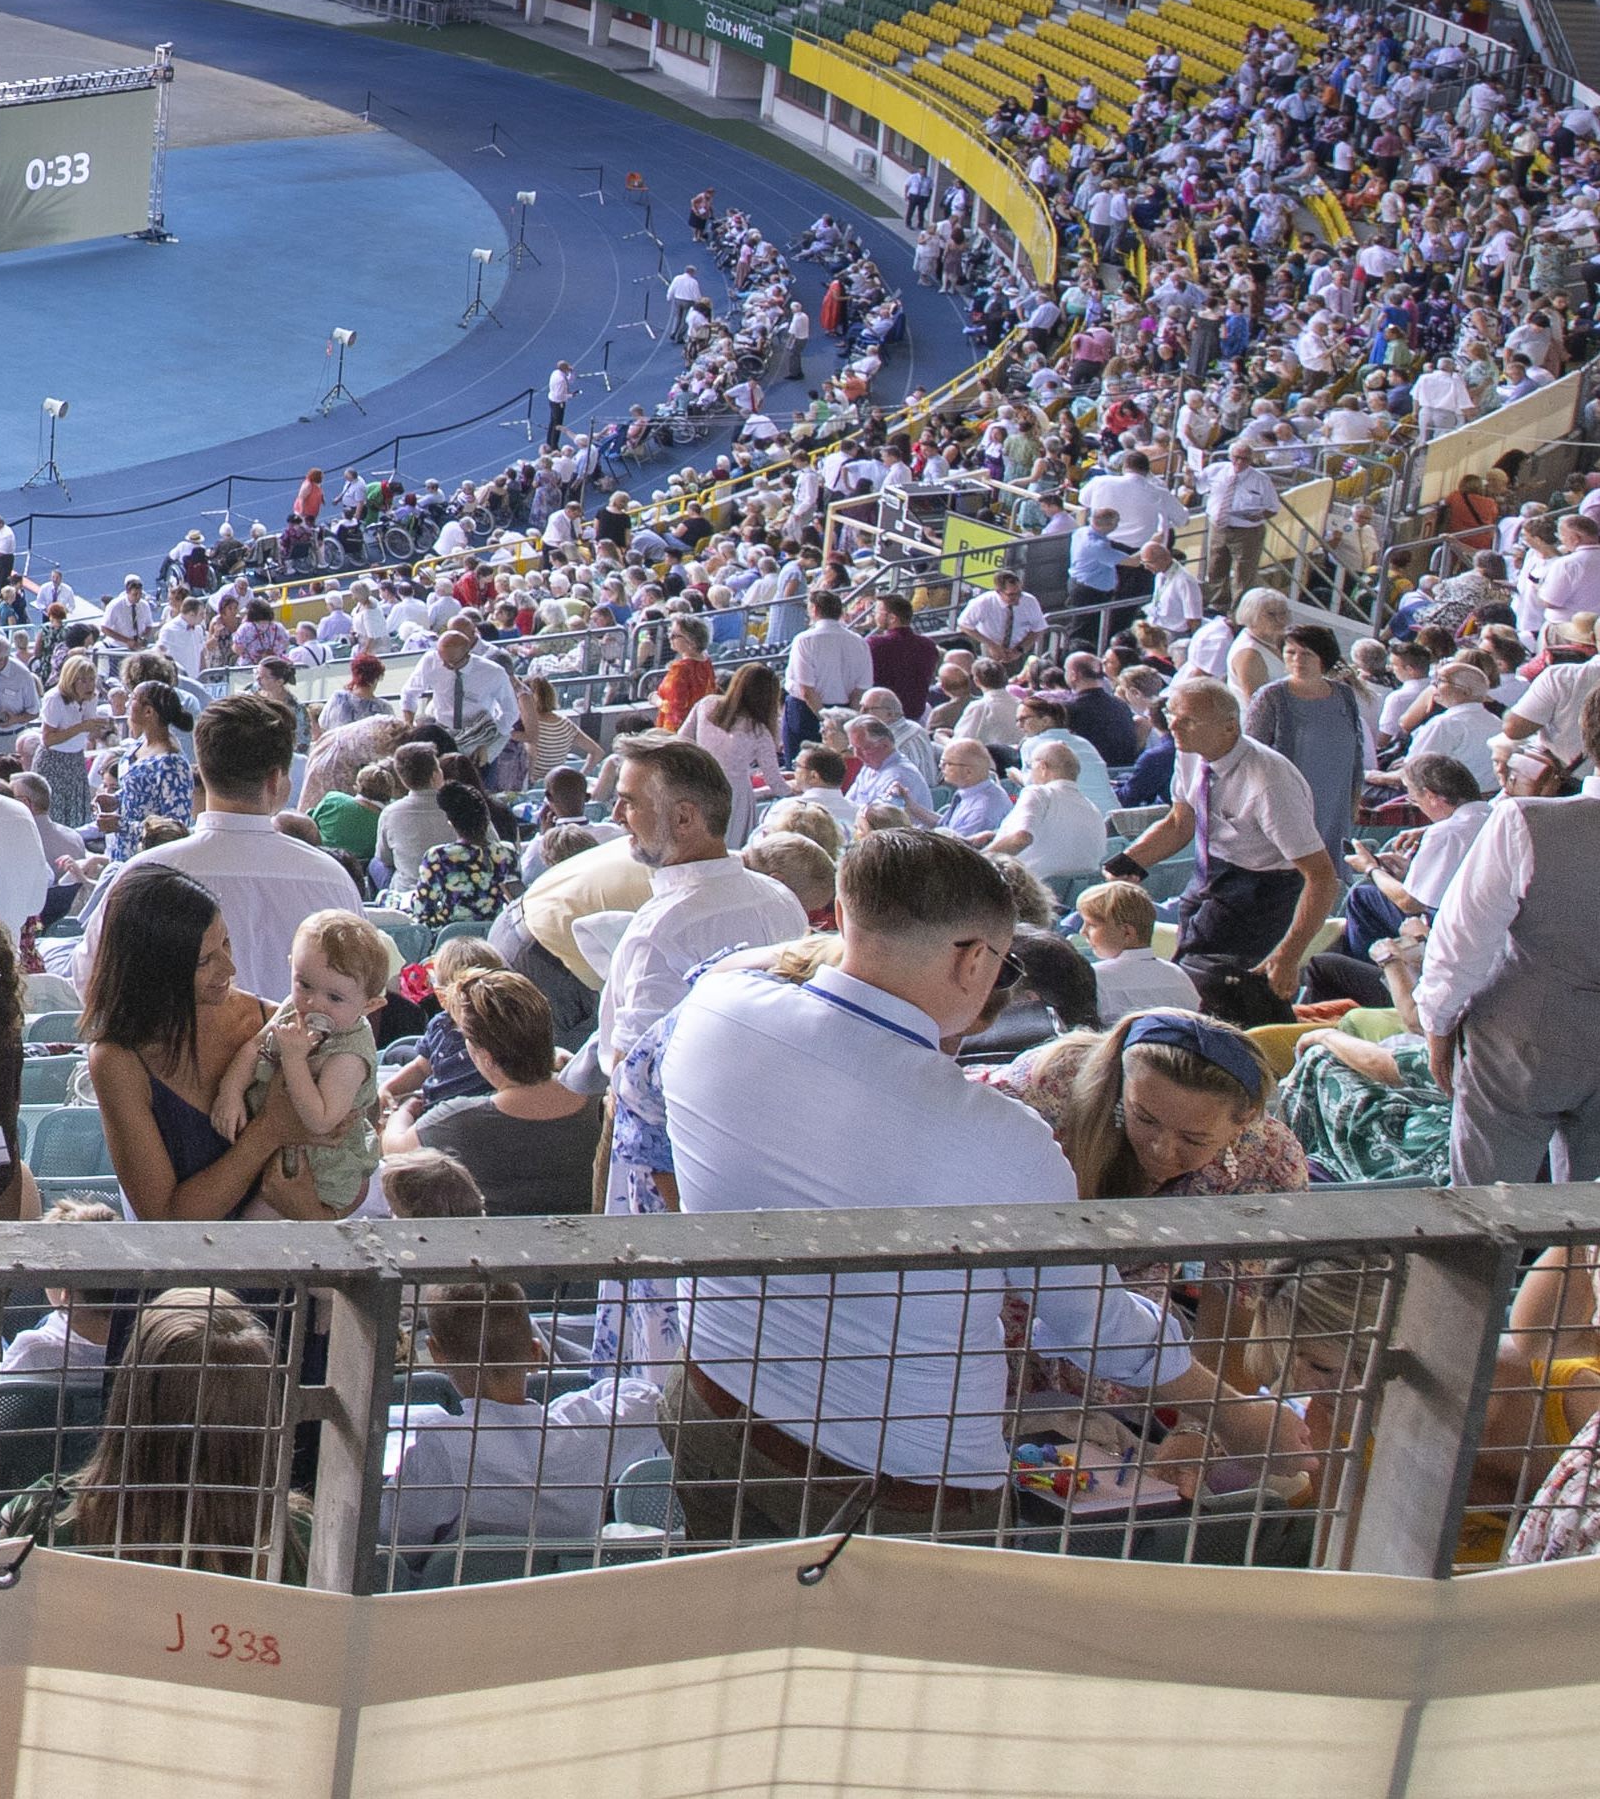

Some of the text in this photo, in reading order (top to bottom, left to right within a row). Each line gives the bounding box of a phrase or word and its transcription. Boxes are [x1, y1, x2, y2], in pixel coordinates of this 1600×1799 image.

[737, 23, 765, 49] Wien
[25, 153, 89, 190] 0:33
[166, 1613, 281, 1667] J 338
